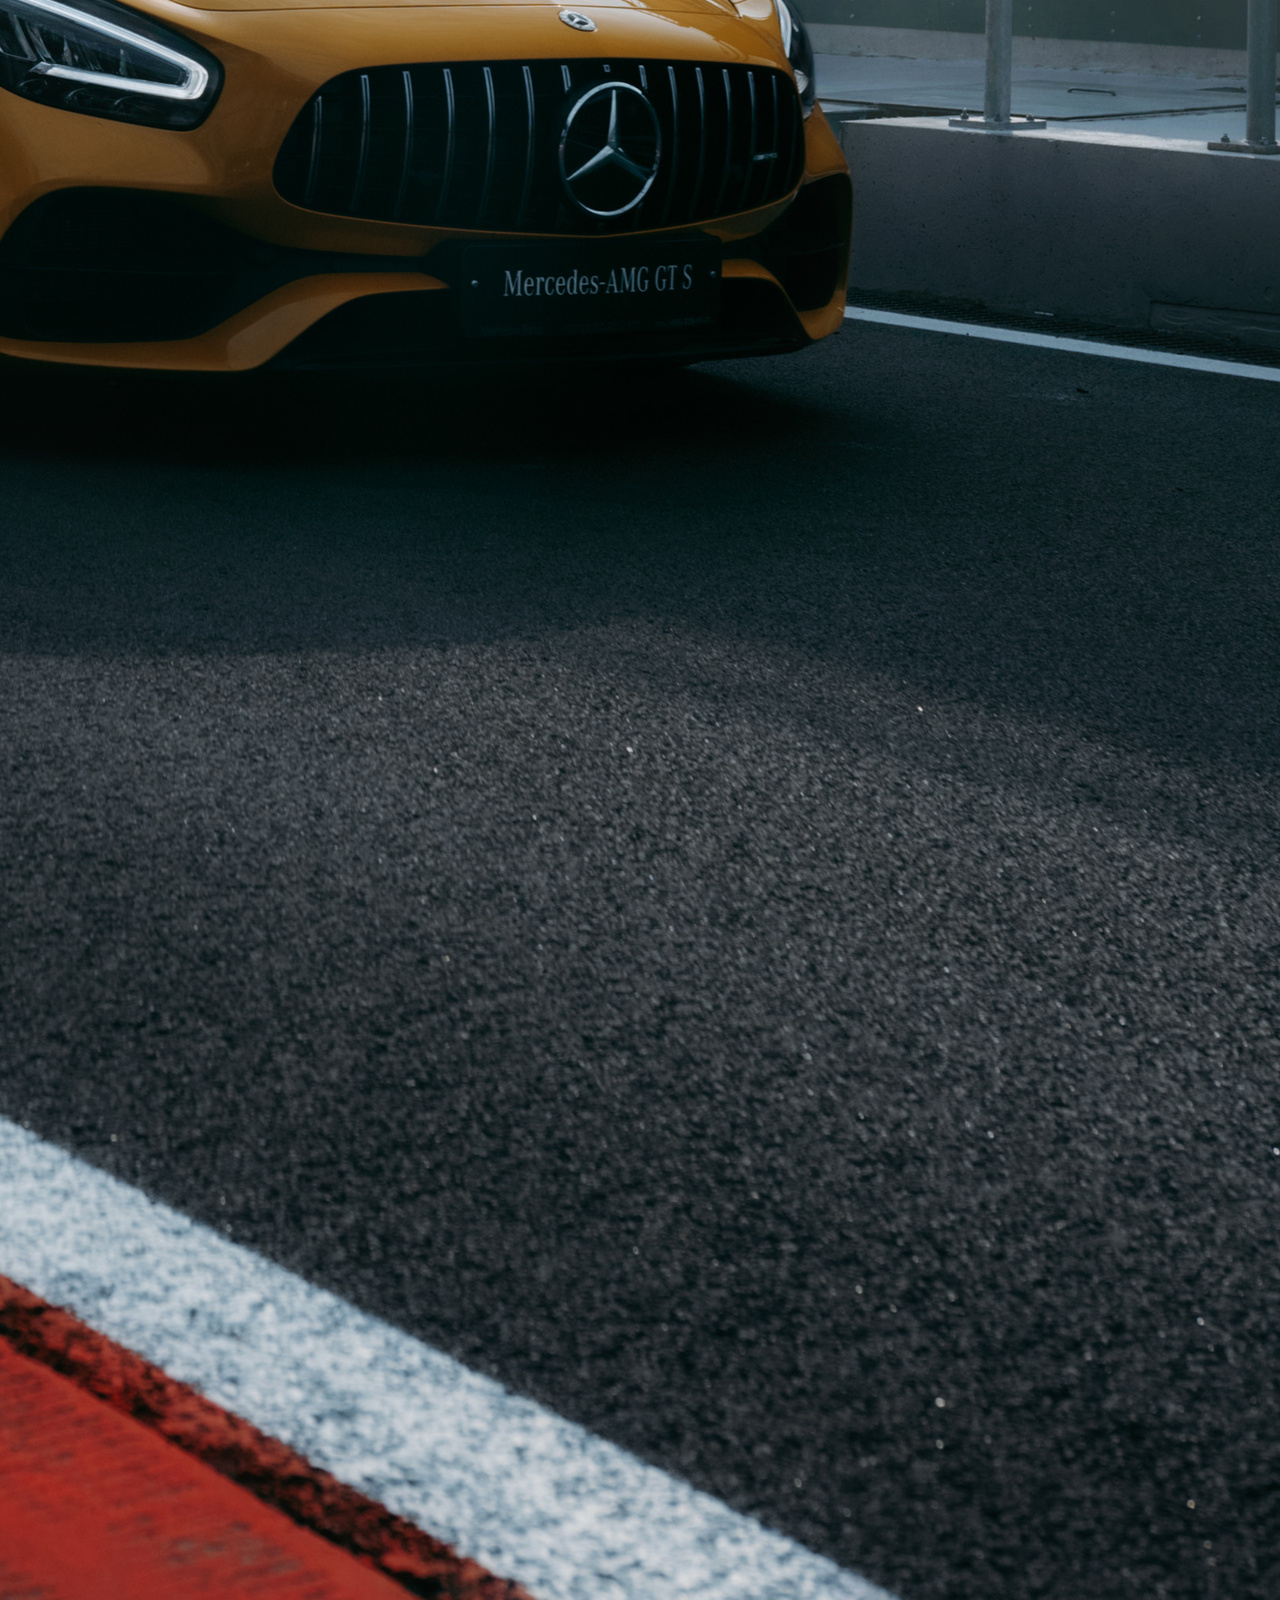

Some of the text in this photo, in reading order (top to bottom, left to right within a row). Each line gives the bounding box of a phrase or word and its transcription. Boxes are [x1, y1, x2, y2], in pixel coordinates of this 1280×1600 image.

[503, 263, 693, 297] Mercedes-AMG GT S
